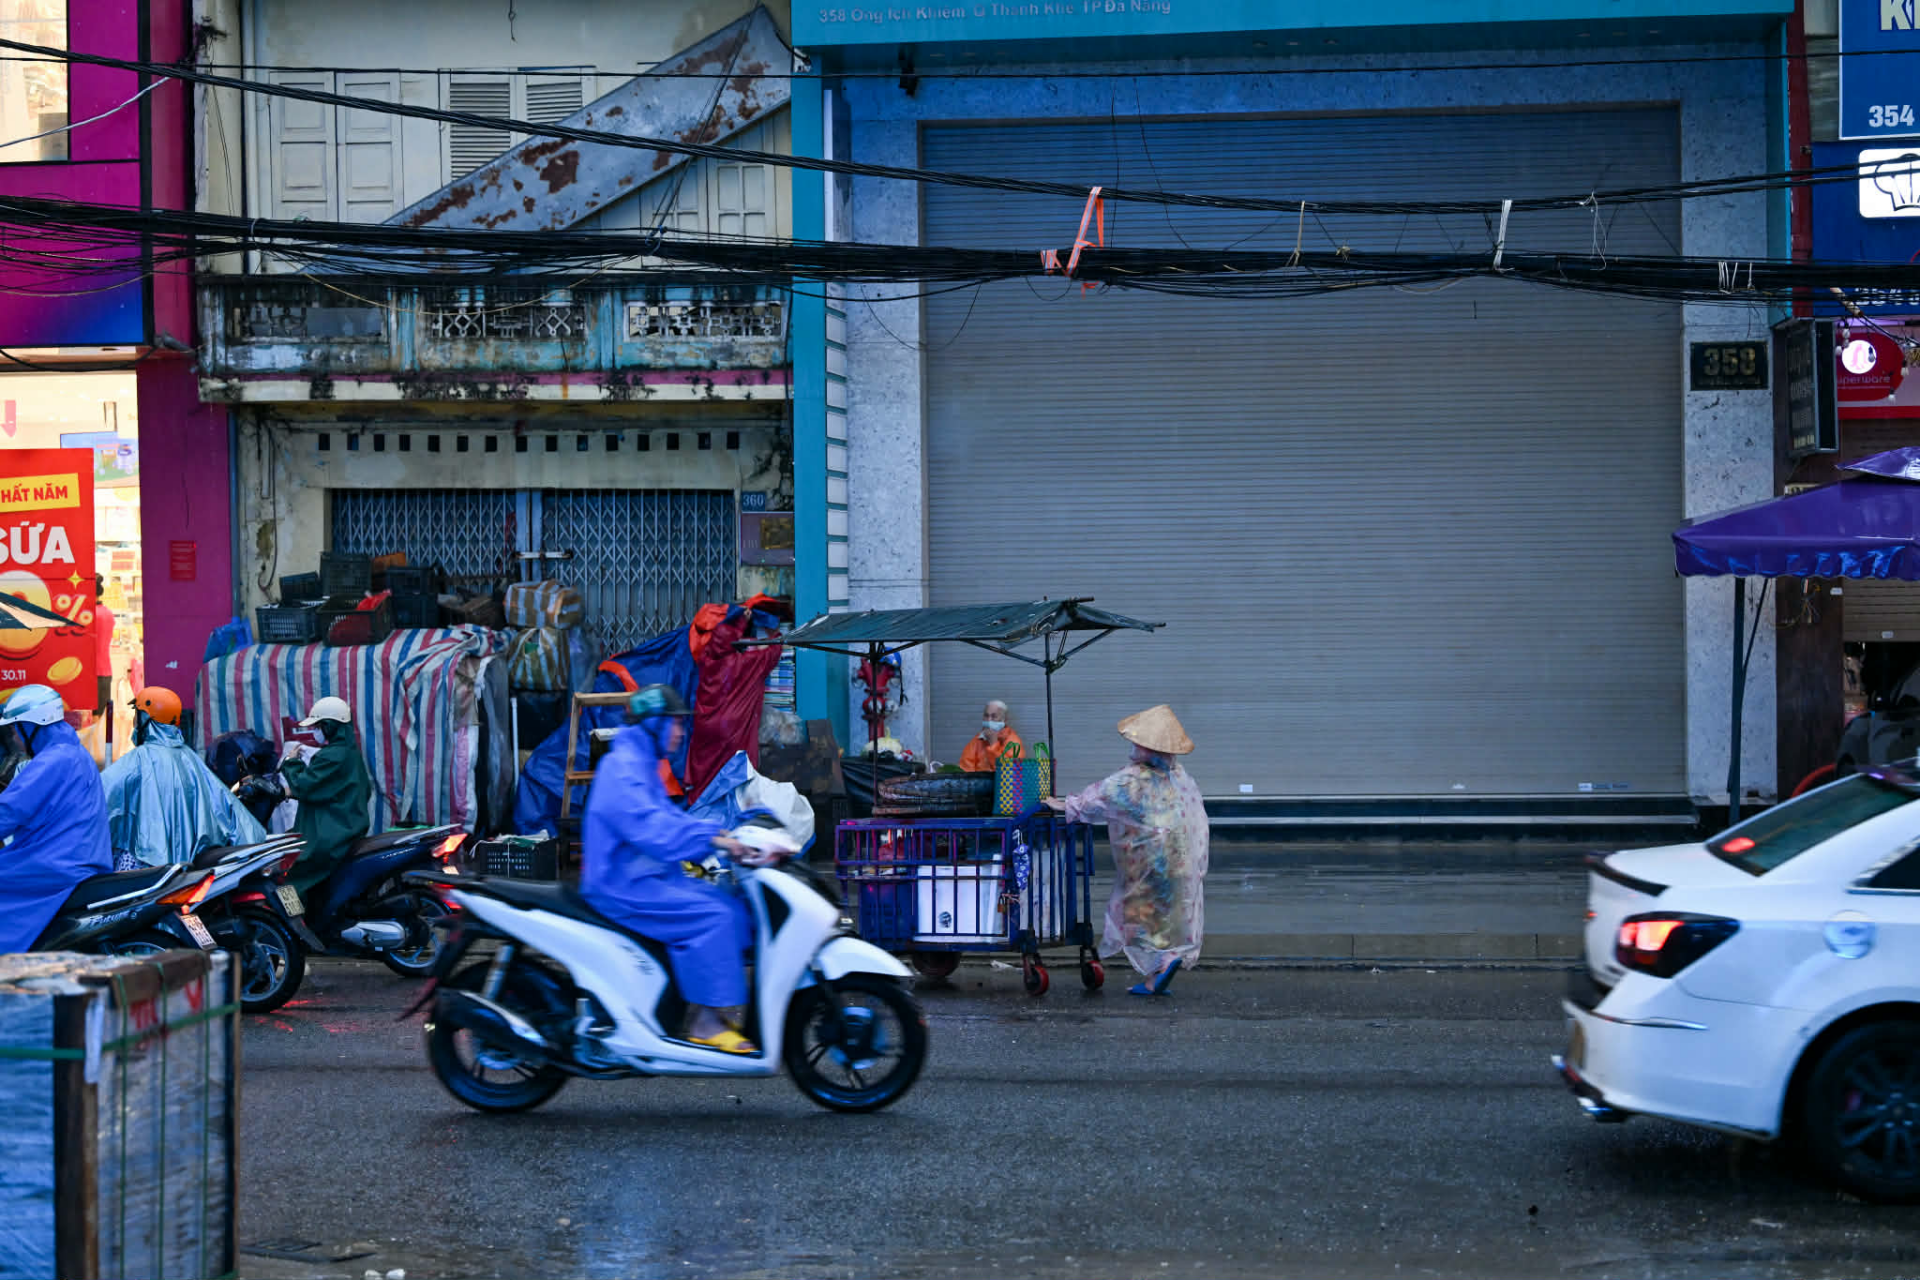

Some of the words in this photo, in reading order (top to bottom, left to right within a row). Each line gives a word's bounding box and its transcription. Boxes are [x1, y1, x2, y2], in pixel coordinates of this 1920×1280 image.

[819, 8, 847, 23] 358
[991, 2, 1039, 16] Thanh
[1868, 104, 1915, 128] 354
[33, 482, 69, 502] NĂM
[743, 494, 765, 507] 360
[1, 669, 27, 681] 30.11
